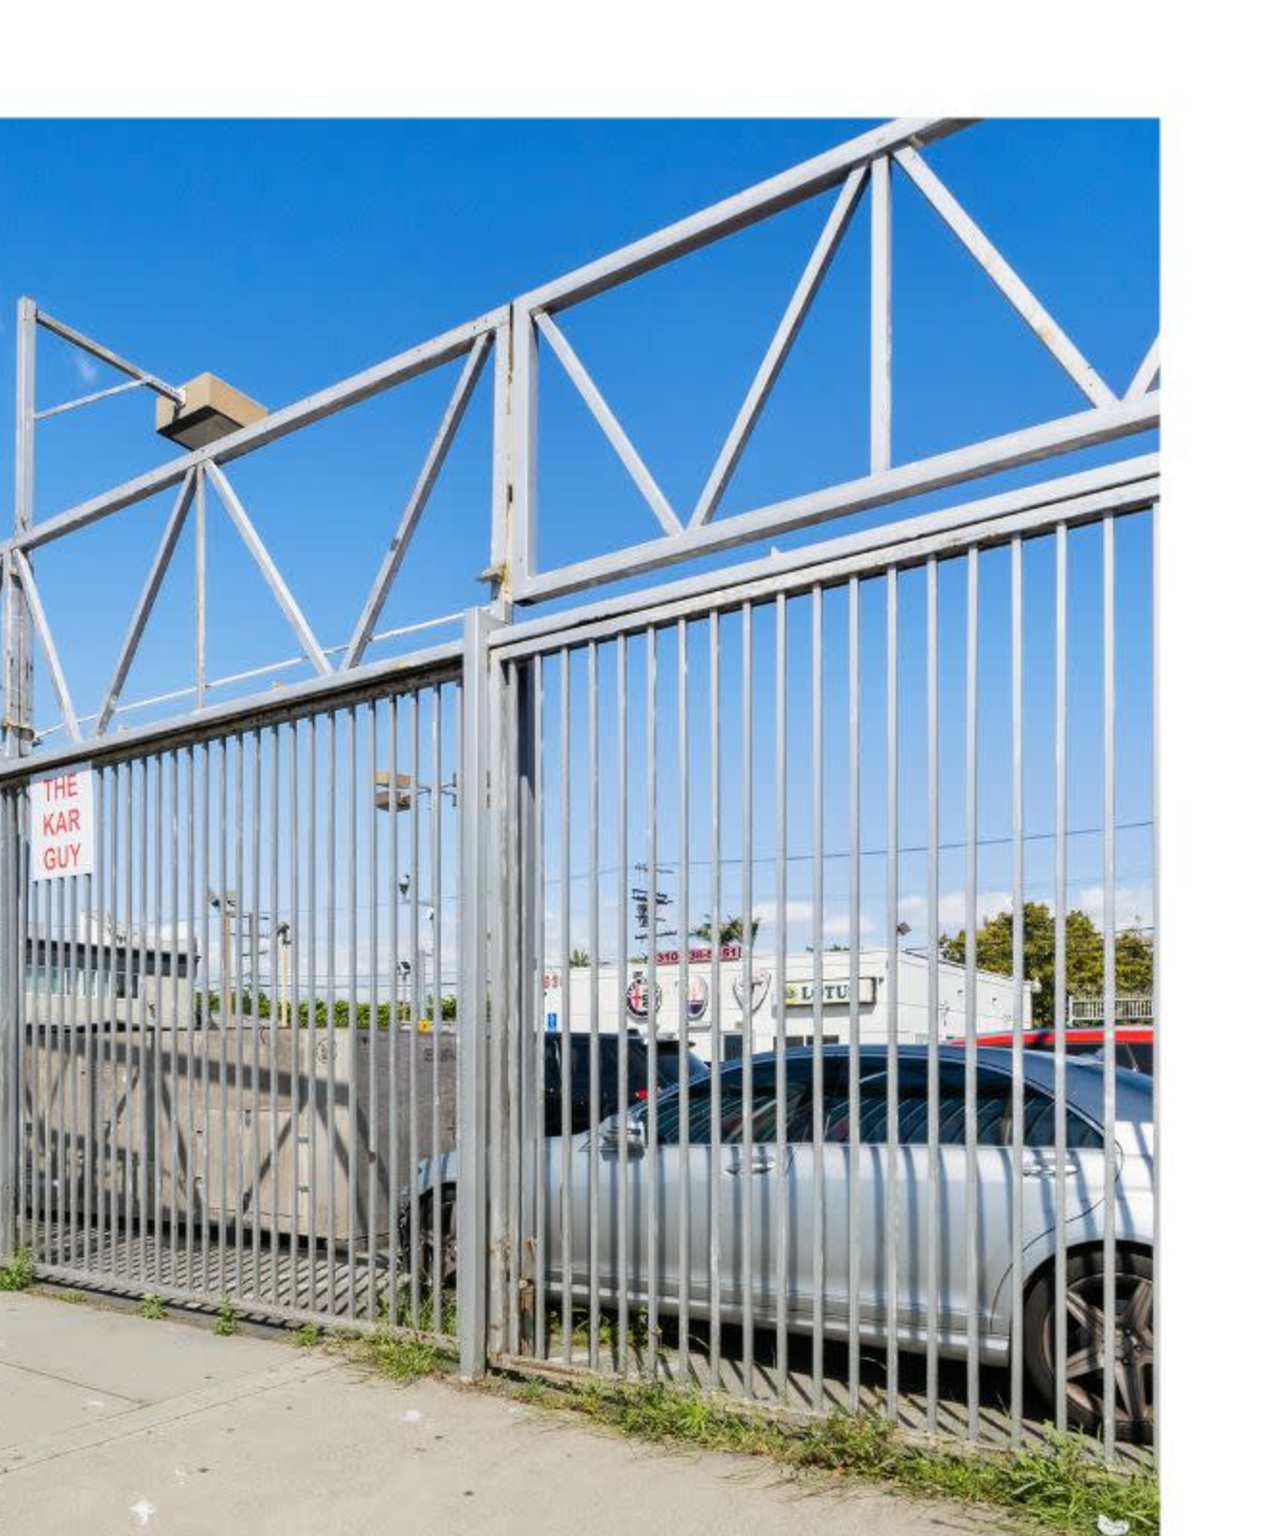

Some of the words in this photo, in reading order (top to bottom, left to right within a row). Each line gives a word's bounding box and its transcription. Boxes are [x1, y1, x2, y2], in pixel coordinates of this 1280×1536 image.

[43, 774, 78, 801] THE
[43, 809, 80, 836] KAR
[43, 843, 80, 870] GUY
